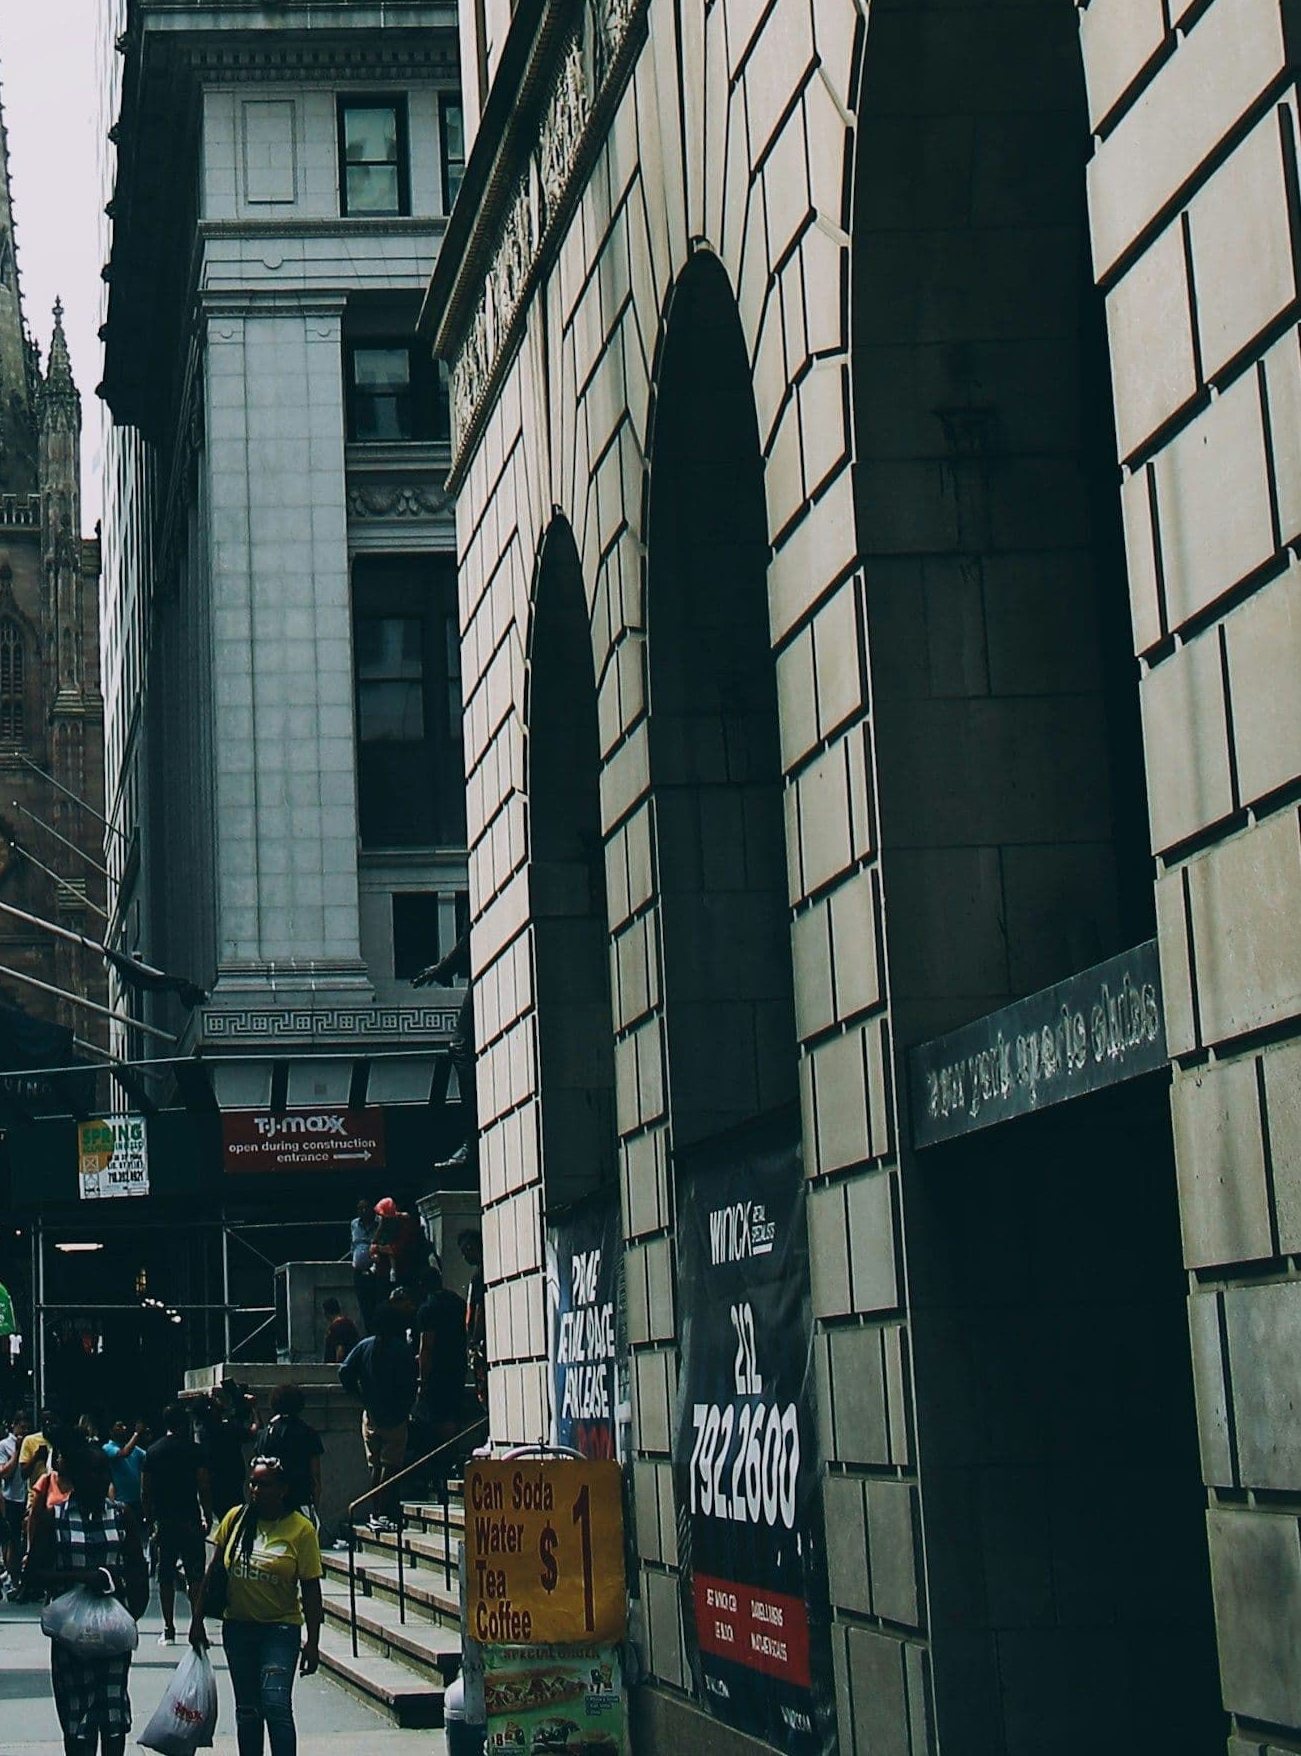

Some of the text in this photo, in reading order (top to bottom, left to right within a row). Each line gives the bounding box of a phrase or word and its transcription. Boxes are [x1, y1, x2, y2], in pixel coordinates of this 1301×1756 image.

[229, 1138, 377, 1155] open during construction
[276, 1152, 330, 1163] entrance
[709, 1200, 752, 1266] WINICK
[731, 1302, 762, 1395] 212
[690, 1402, 800, 1529] 792.2600
[471, 1470, 554, 1511] Can Soda
[474, 1515, 524, 1555] Water
[475, 1559, 507, 1599] Tea
[476, 1601, 532, 1640] Coffee
